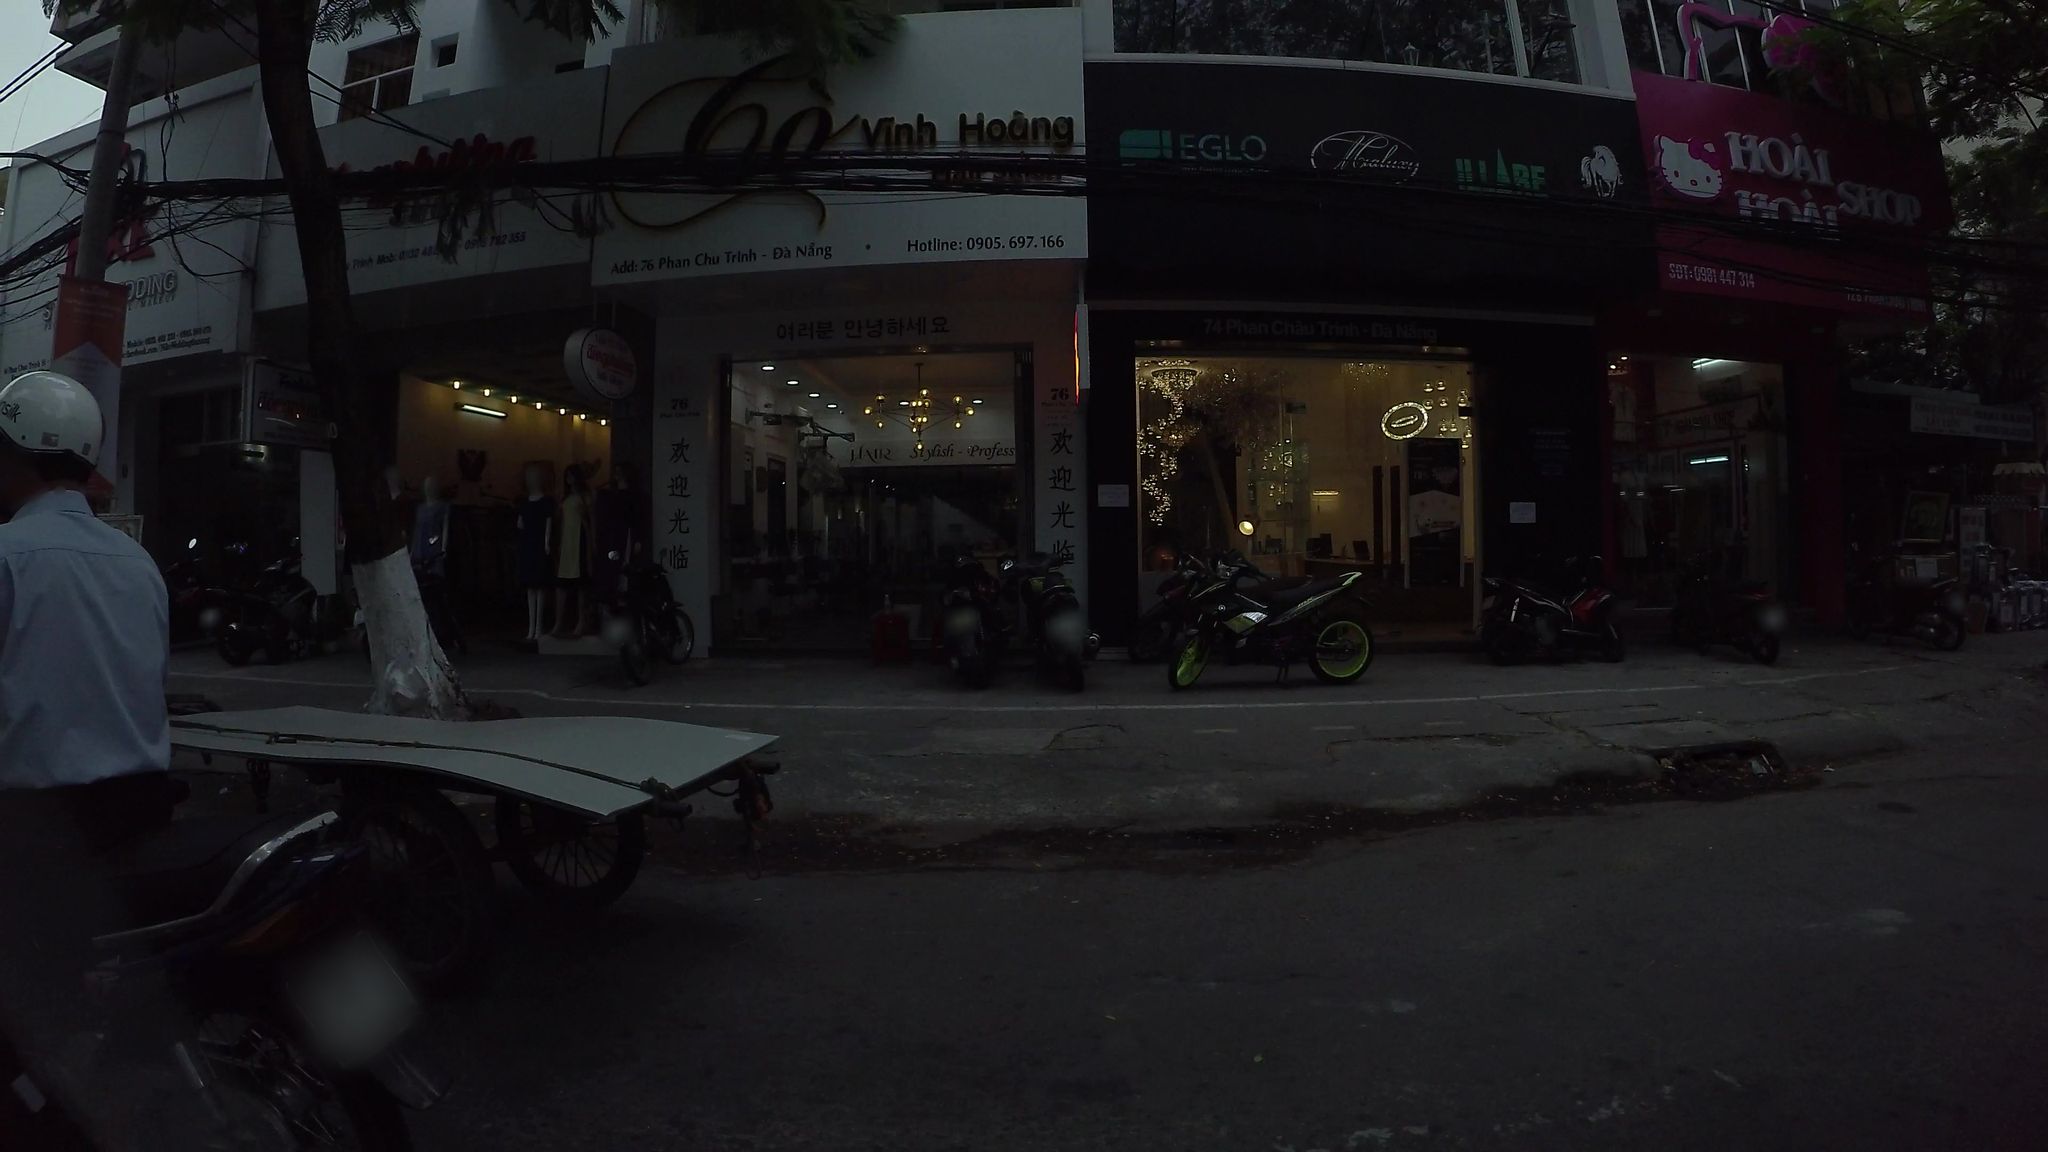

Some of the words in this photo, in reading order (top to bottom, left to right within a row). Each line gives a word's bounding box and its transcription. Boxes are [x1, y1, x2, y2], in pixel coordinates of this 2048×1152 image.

[959, 110, 1074, 149] Hoàng
[1179, 134, 1267, 161] EGLO
[1724, 131, 1834, 187] HOÀI
[1837, 180, 1922, 225] SHOP
[907, 238, 962, 252] Hotline:
[611, 260, 638, 274] Add:
[640, 258, 654, 272] 76
[658, 255, 690, 270] Phan
[695, 252, 720, 267] Chu
[772, 246, 791, 260] Đà
[1720, 269, 1737, 286] 447
[1738, 271, 1755, 288] 314
[777, 320, 833, 341] 여러분
[845, 316, 950, 338] 안녕하세요
[1203, 318, 1222, 335] 74
[1226, 318, 1269, 336] Phan
[671, 397, 688, 410] 76
[1050, 388, 1069, 401] 76
[850, 445, 896, 464] HAIR
[667, 437, 692, 570] 欢迎光临
[1048, 428, 1076, 565] 欢迎光临
